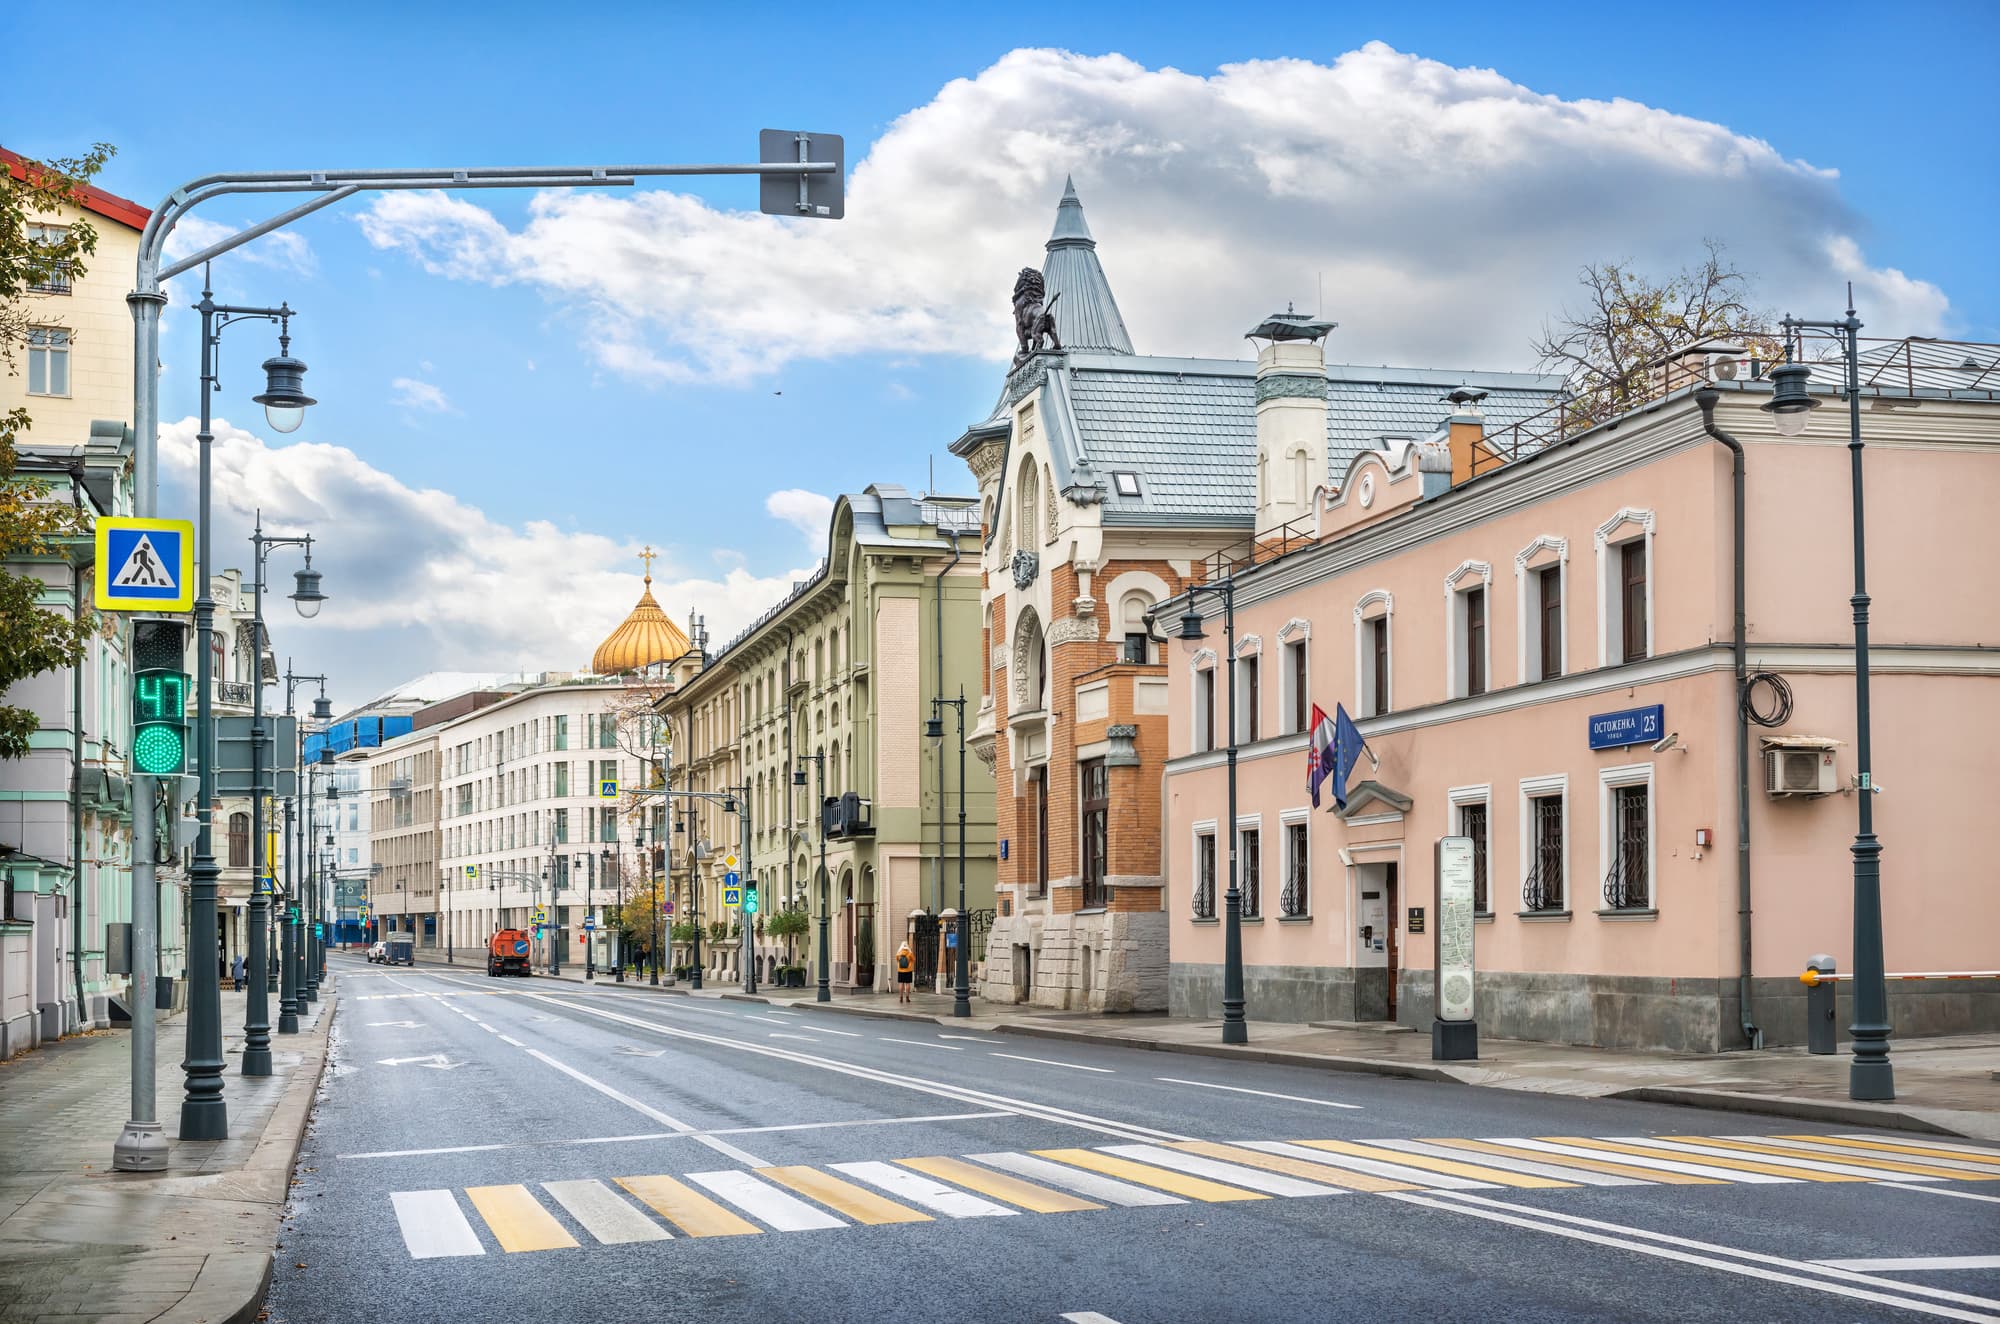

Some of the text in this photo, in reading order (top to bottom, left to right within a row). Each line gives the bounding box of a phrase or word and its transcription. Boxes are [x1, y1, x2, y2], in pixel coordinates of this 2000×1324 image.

[140, 678, 182, 717] 47
[1594, 717, 1636, 734] ОСТОЖЕНКА
[1643, 715, 1656, 733] 23
